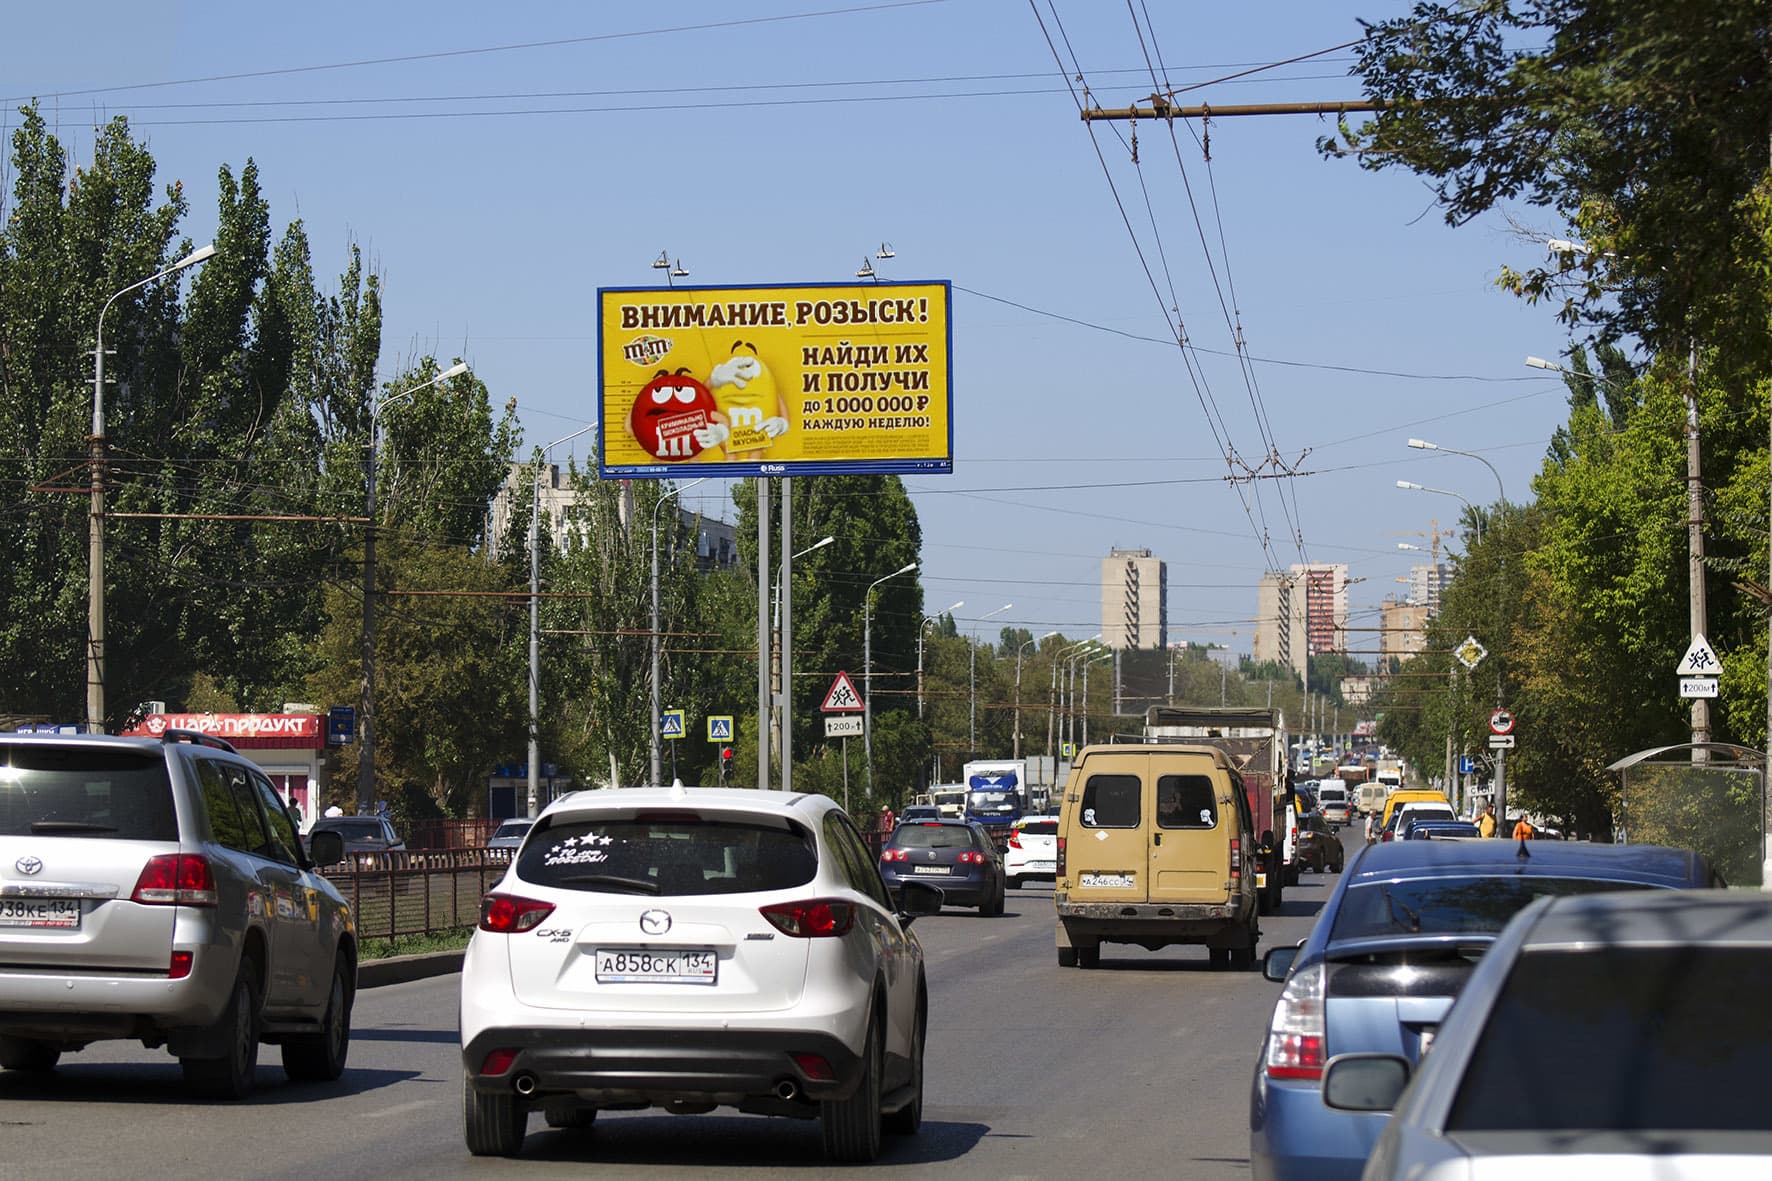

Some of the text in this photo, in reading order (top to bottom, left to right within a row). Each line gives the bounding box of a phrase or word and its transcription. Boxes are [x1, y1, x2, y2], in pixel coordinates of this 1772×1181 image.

[621, 298, 928, 329] ВНИМАНИЕ, РОЗЫСК!
[802, 341, 928, 369] НАЙДИ ИХ
[803, 371, 929, 393] И ПОЛУЧИ
[803, 416, 930, 431] КАЖДУЮ НЕДЕЛЮ!
[536, 929, 573, 937] CX-5
[602, 953, 710, 973] А858СК 134
